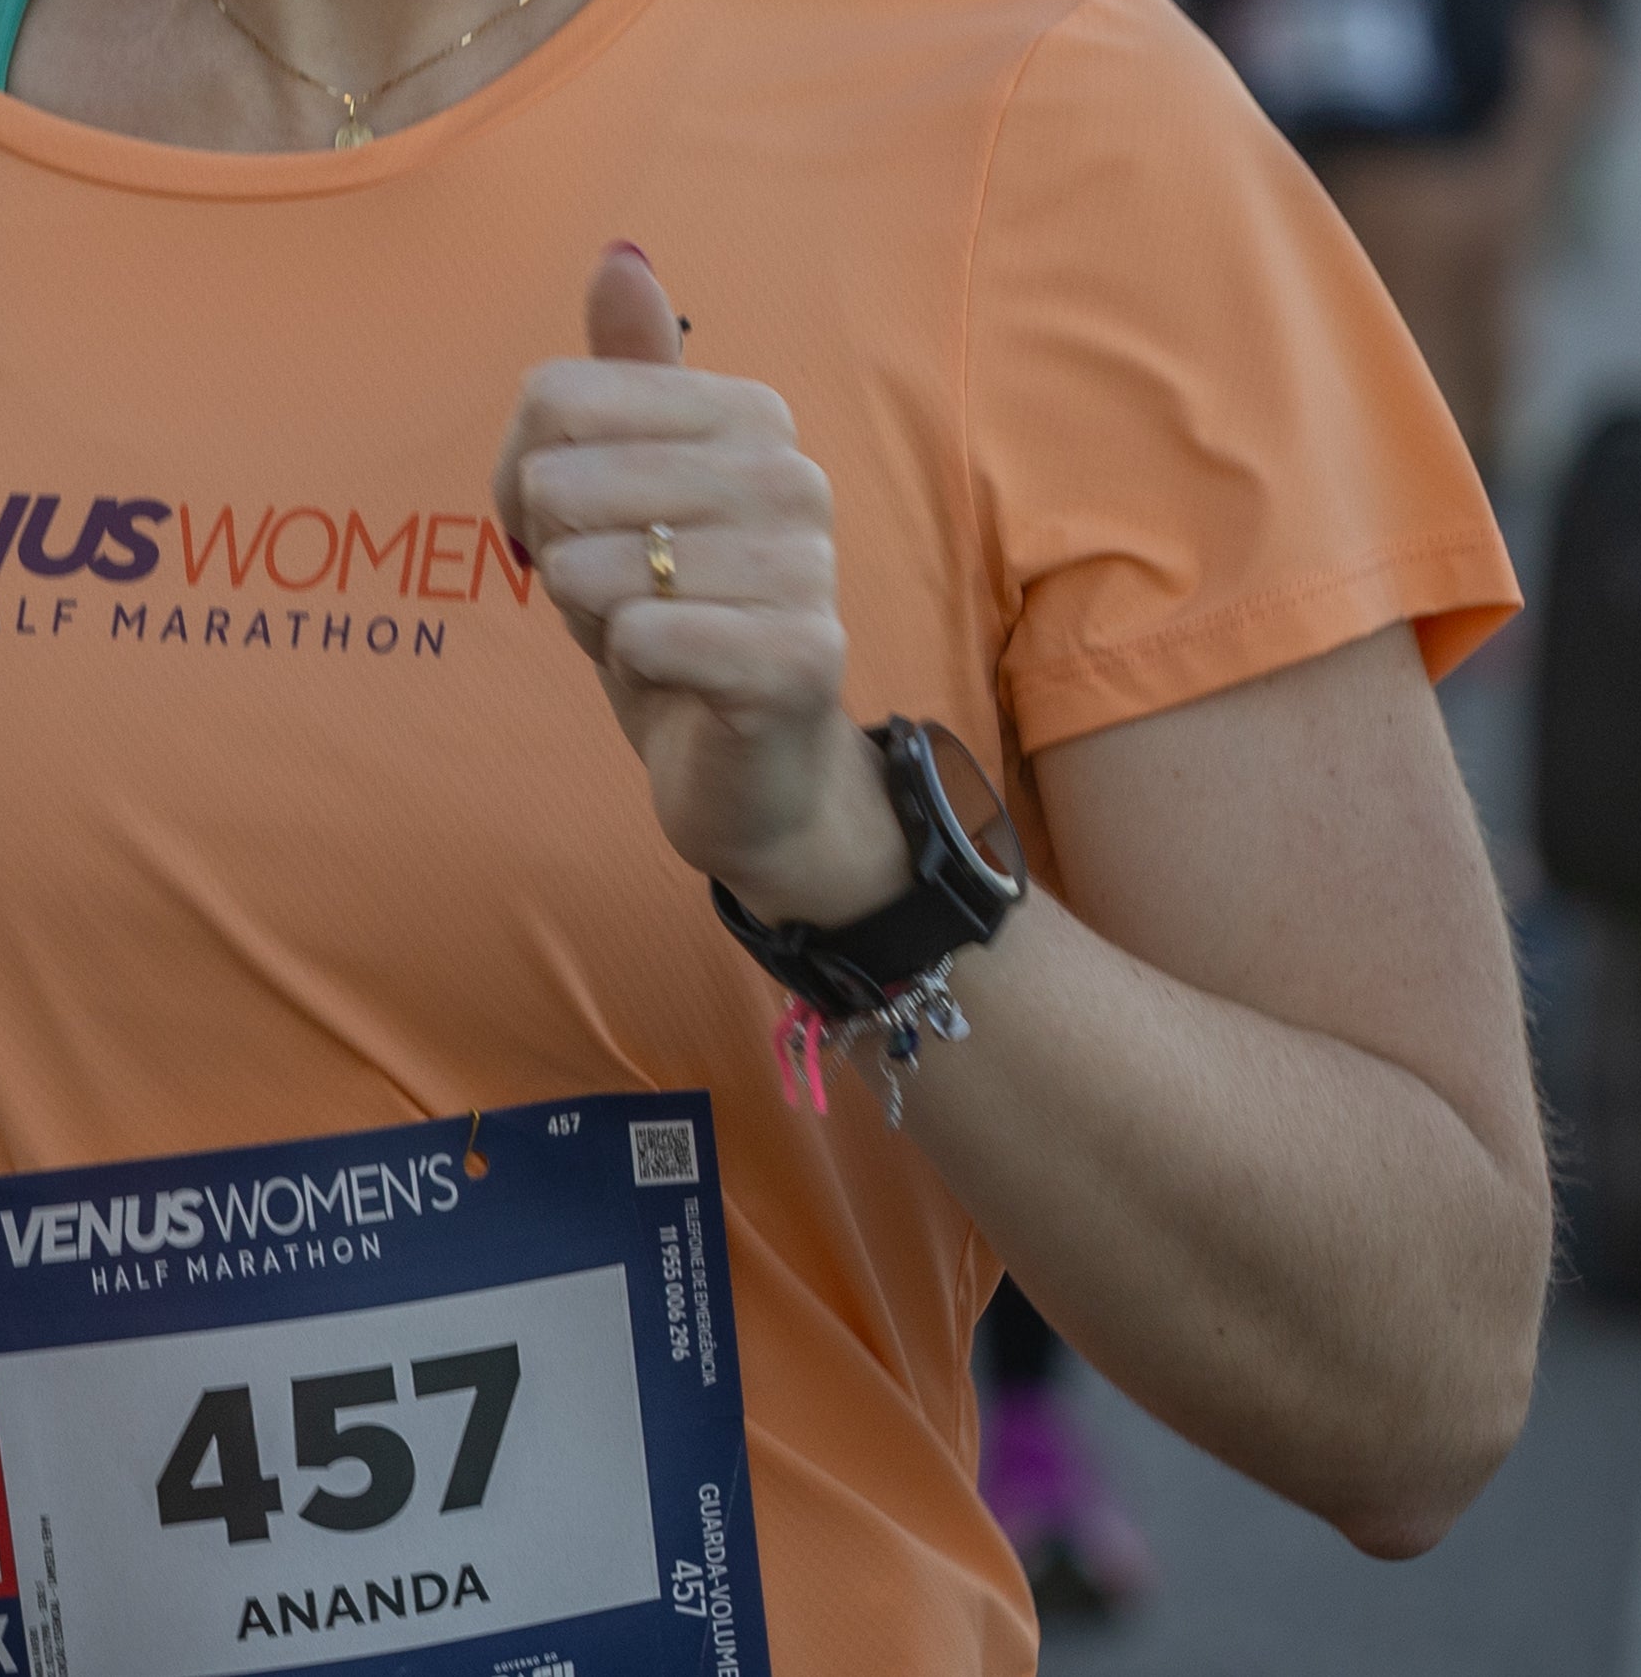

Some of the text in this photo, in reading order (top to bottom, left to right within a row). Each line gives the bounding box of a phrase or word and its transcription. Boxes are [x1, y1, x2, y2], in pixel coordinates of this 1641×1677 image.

[111, 602, 446, 658] MARATHON
[548, 1112, 581, 1137] 457
[91, 1232, 382, 1295] HALF MARATHON
[659, 1224, 692, 1362] 11 955 006 296
[684, 1196, 717, 1387] TELEFONE DE EMERGÊNCIA
[157, 1341, 522, 1546] 457
[235, 1563, 491, 1641] ANANDA
[670, 1559, 708, 1617] 457
